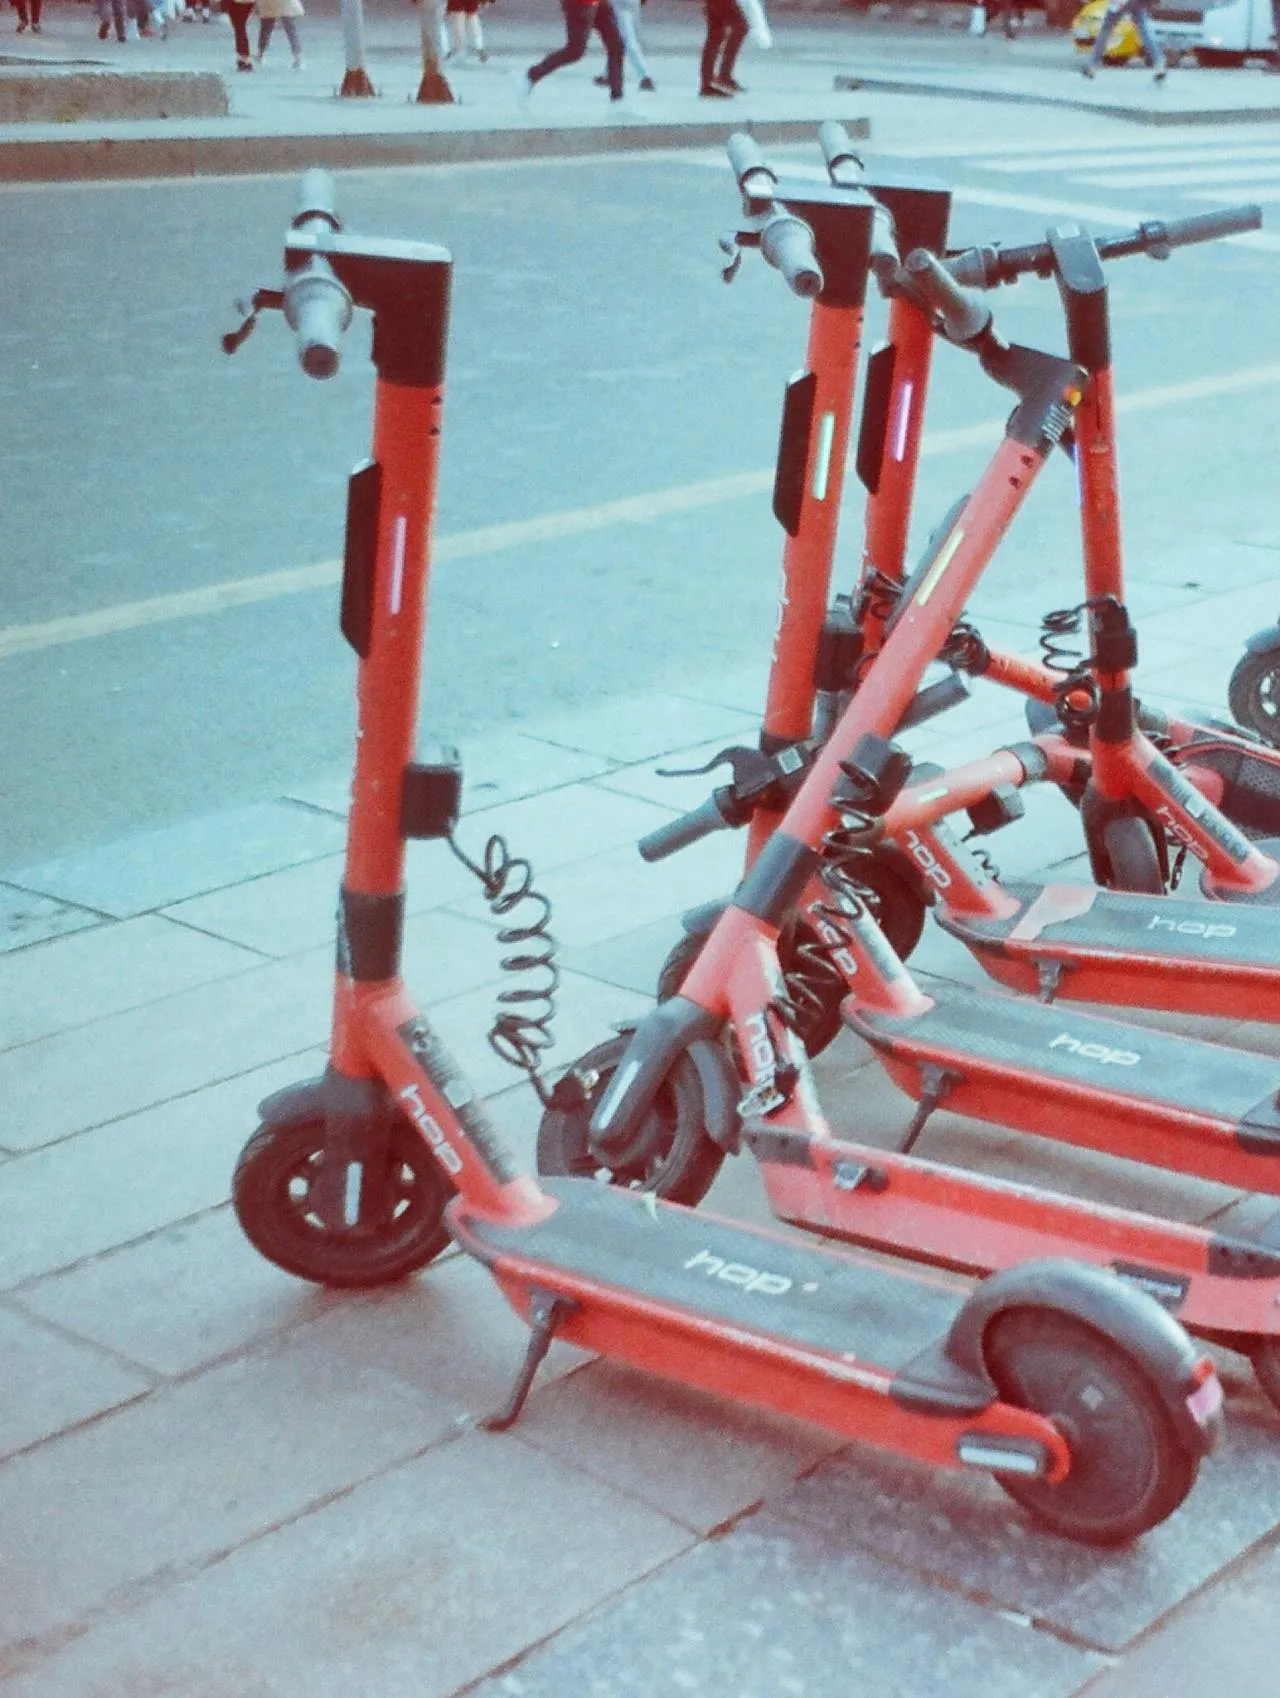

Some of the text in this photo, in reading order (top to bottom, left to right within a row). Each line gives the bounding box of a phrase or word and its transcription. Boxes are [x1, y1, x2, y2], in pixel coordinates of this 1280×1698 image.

[1156, 805, 1209, 860] hop
[1147, 915, 1237, 938] hop
[1049, 1032, 1141, 1066] hop
[400, 1083, 463, 1175] hop
[684, 1249, 792, 1294] hop
